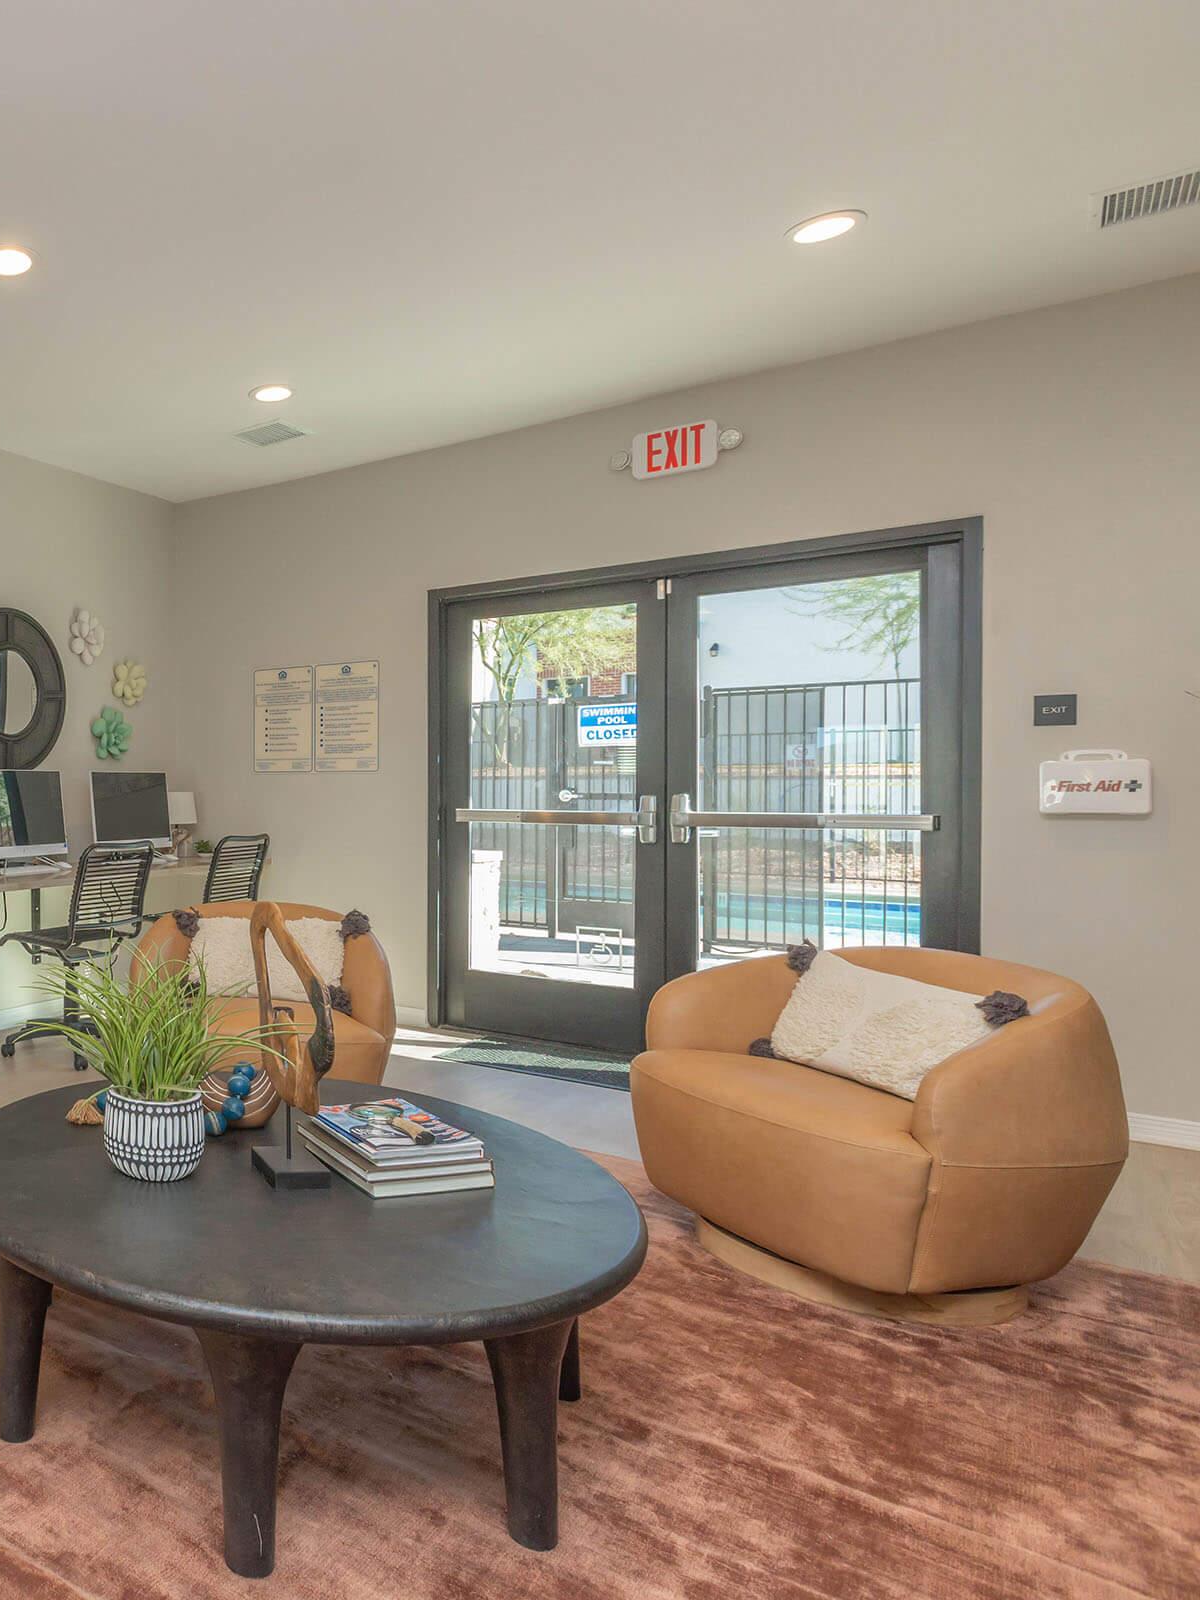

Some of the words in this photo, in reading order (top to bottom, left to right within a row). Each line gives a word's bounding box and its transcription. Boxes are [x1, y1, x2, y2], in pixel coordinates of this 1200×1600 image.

[646, 423, 706, 473] EXIT
[582, 706, 637, 717] SWIMMIN
[1042, 705, 1069, 714] EXIT
[597, 716, 629, 725] POOL
[1057, 779, 1093, 793] First
[1093, 779, 1123, 793] Aid
